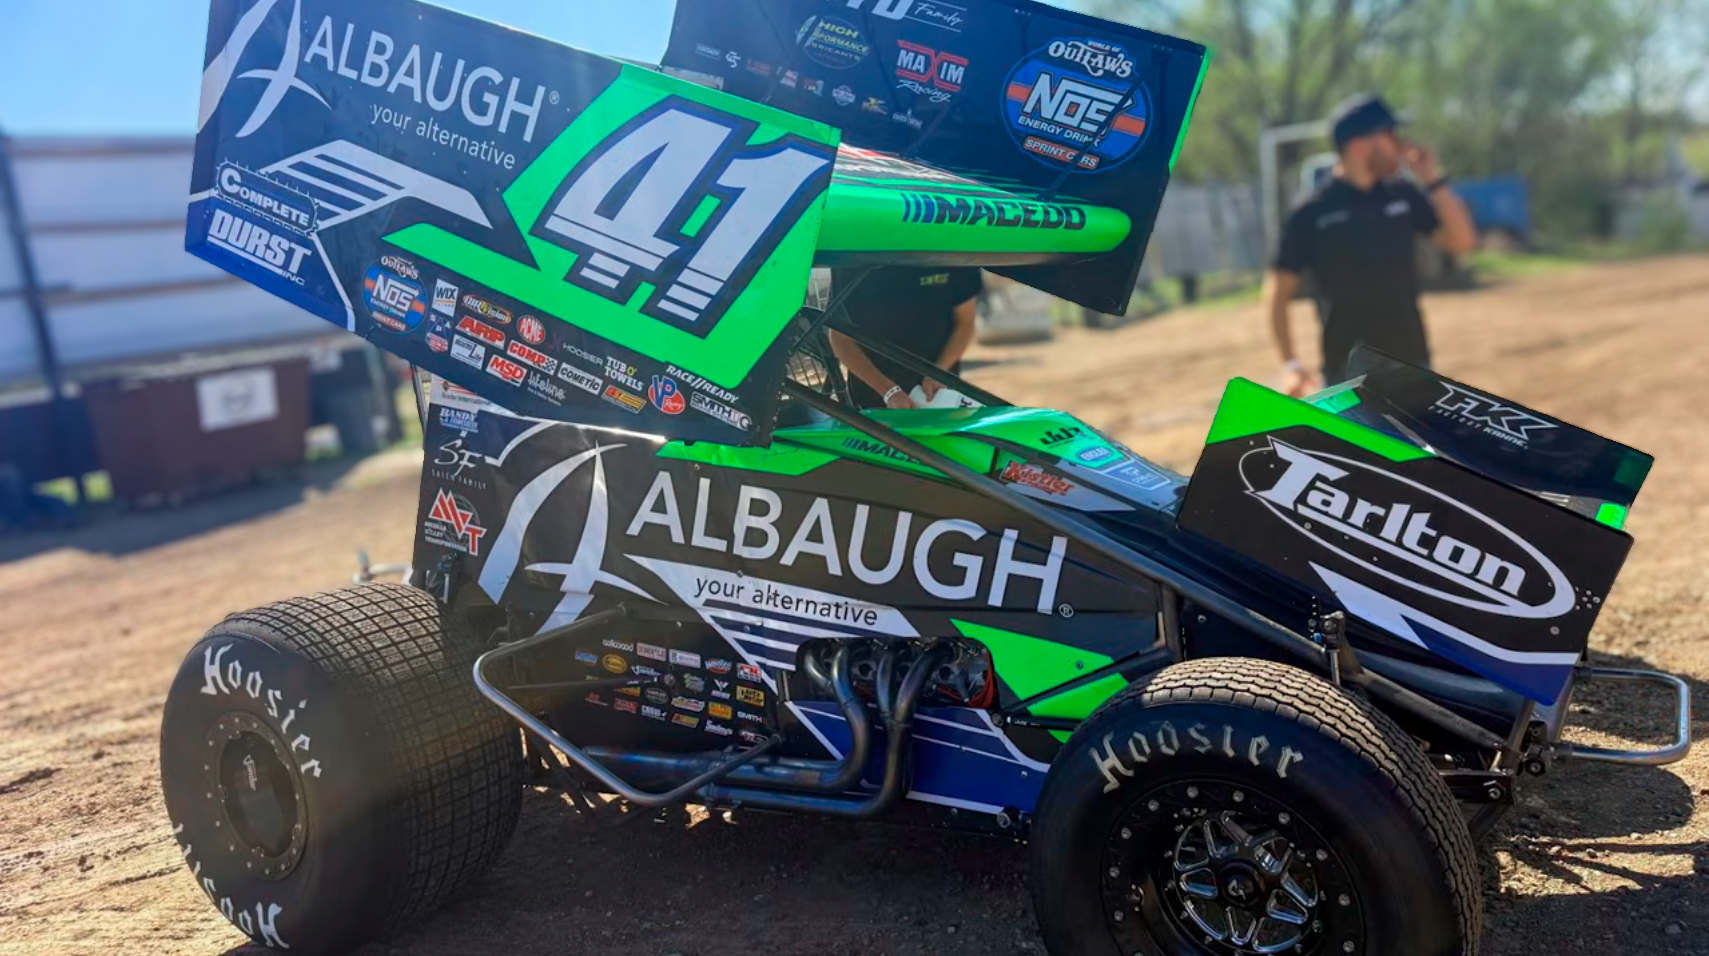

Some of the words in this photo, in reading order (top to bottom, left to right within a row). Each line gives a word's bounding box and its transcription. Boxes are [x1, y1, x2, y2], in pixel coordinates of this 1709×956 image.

[818, 18, 860, 39] HIGH
[304, 14, 546, 143] ALBAUGH
[896, 42, 967, 90] MAXIM
[1048, 40, 1133, 78] OUTLAWS
[370, 103, 412, 131] your
[415, 118, 516, 170] alternative
[1017, 115, 1063, 136] ENERGY
[1024, 138, 1067, 158] SPRINT
[1066, 150, 1098, 167] CRS
[542, 106, 832, 323] 41
[207, 207, 313, 275] DURST
[372, 273, 420, 314] NOS
[435, 286, 457, 300] WIX
[490, 357, 525, 380] MSD
[509, 342, 547, 367] COMP
[606, 355, 628, 373] TUB
[604, 366, 645, 391] TOWELS
[651, 374, 677, 411] VP
[1004, 461, 1076, 492] Kistler
[1259, 440, 1528, 598] Tarlton
[625, 470, 1069, 615] ALBAUGH
[695, 576, 745, 599] your
[751, 584, 878, 626] alternative
[199, 643, 323, 778] Hoosier
[1087, 720, 1304, 794] Hoosier
